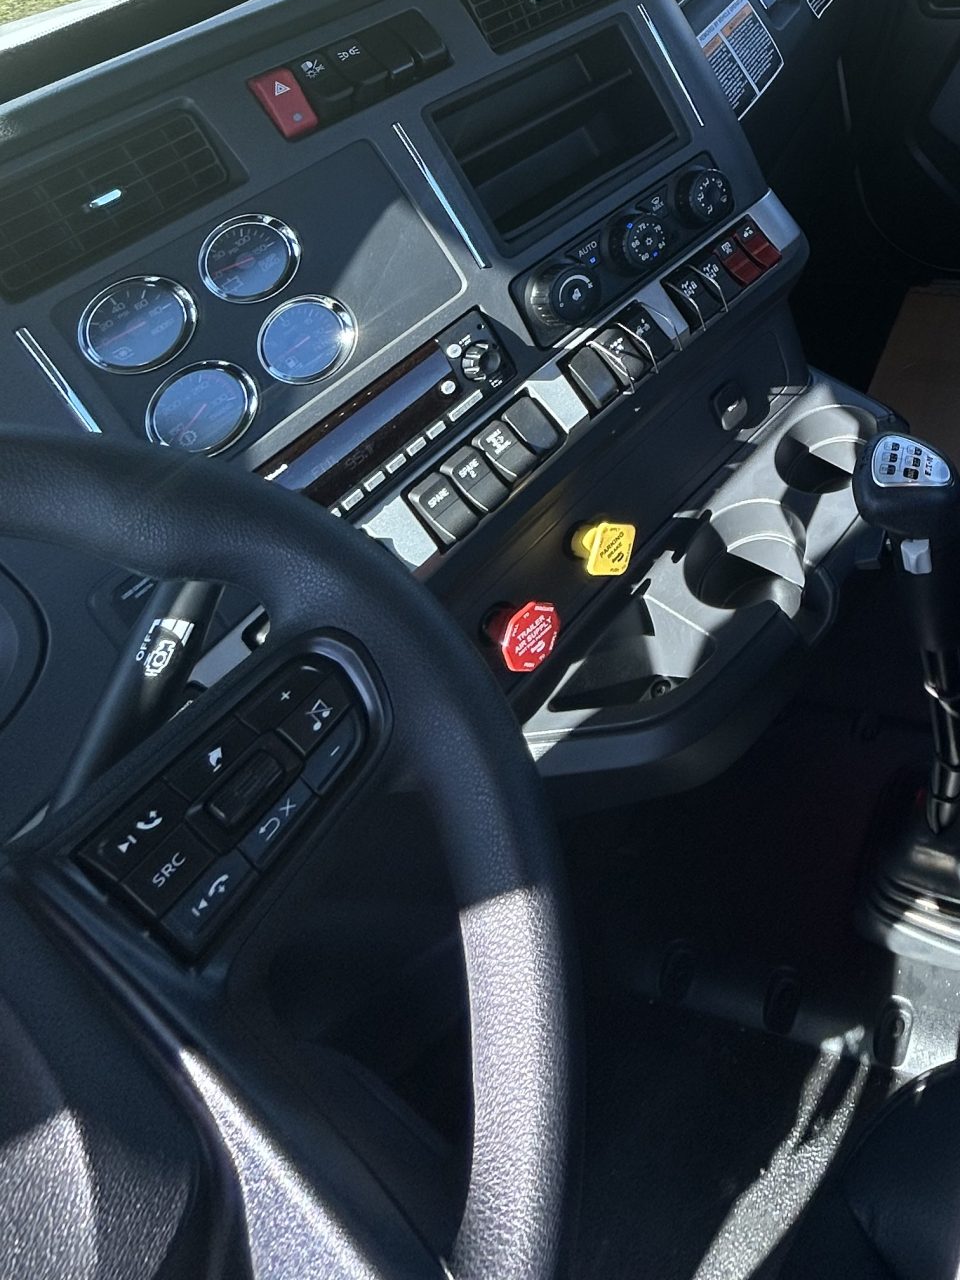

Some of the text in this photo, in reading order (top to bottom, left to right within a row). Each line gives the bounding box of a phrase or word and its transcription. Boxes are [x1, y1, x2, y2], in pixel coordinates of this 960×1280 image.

[578, 240, 598, 259] AUTO
[111, 302, 126, 313] 40
[427, 487, 450, 509] SPARE
[599, 531, 625, 559] PARKING
[607, 542, 623, 559] BRAKE
[515, 616, 553, 654] AIR SUPPLY
[516, 614, 546, 641] TRAILER
[136, 630, 153, 662] OFF
[151, 851, 187, 889] SRC
